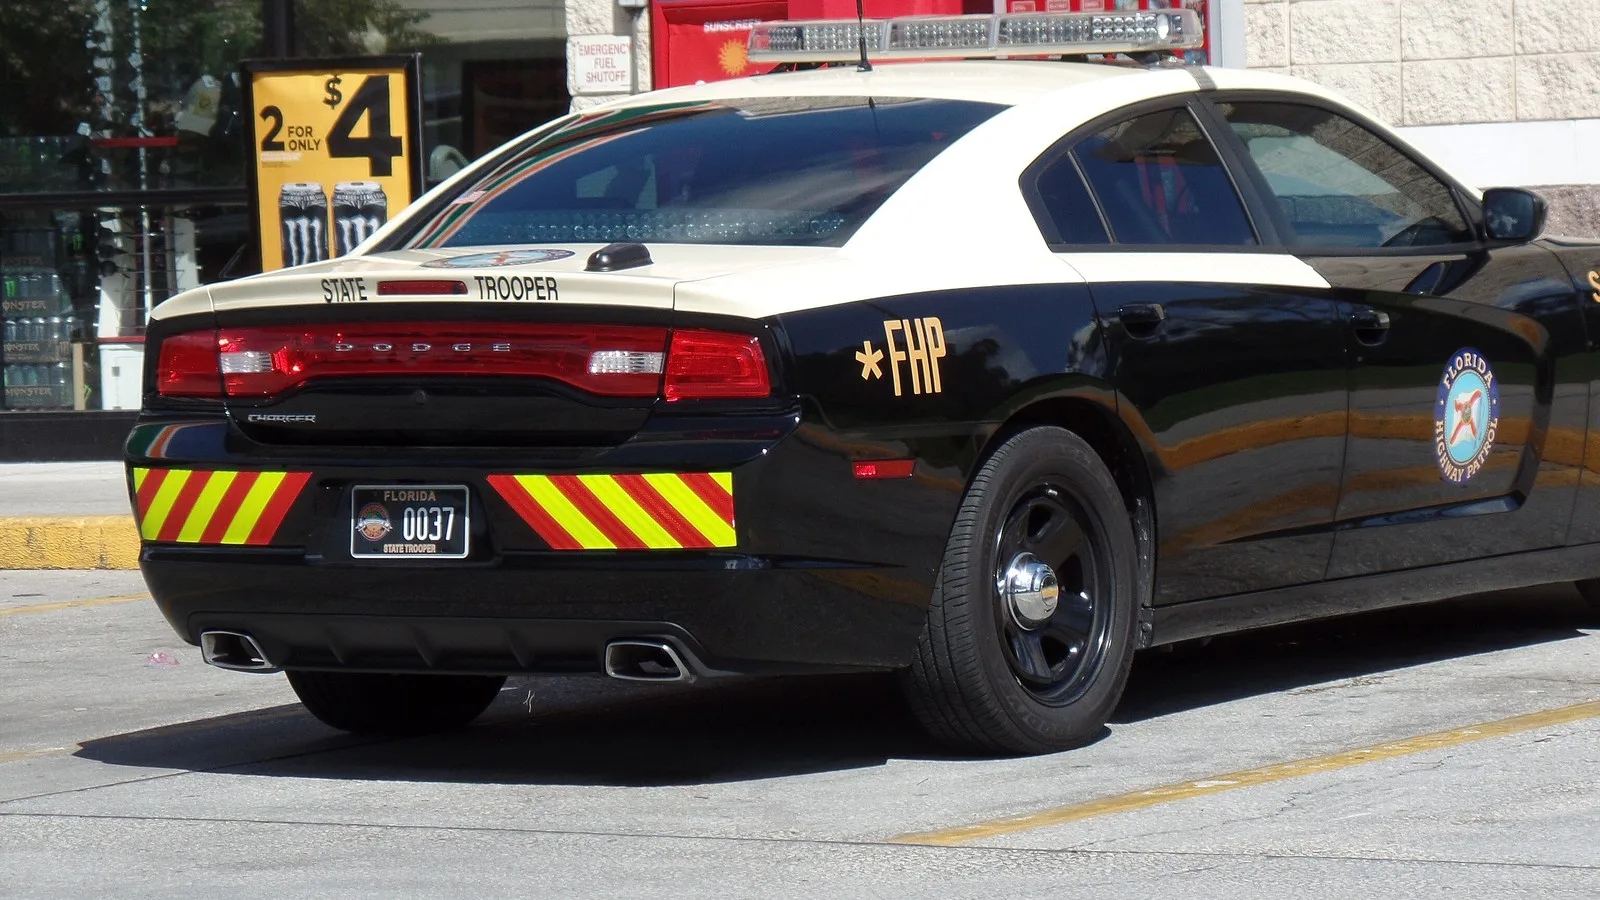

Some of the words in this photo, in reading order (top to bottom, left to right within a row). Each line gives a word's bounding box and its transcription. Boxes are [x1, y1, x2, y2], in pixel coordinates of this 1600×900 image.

[579, 43, 632, 57] EMERGENCY
[594, 56, 617, 69] FUEL
[585, 71, 627, 83] SHUTOFF
[259, 105, 285, 151] 2
[287, 126, 314, 138] FOR
[288, 139, 321, 151] ONLY
[321, 277, 368, 304] STATE
[473, 275, 559, 301] TROOPER
[2, 300, 47, 312] ONSTER
[335, 343, 512, 352] DODGE
[1443, 352, 1493, 390] FLORIDA
[247, 414, 316, 423] CHARGER
[1436, 420, 1465, 482] HIGHWAY
[1466, 417, 1498, 479] PATROL
[384, 491, 436, 502] FLORIDA
[403, 507, 454, 541] 0037
[383, 544, 404, 554] STATE
[405, 544, 437, 554] TROOPER
